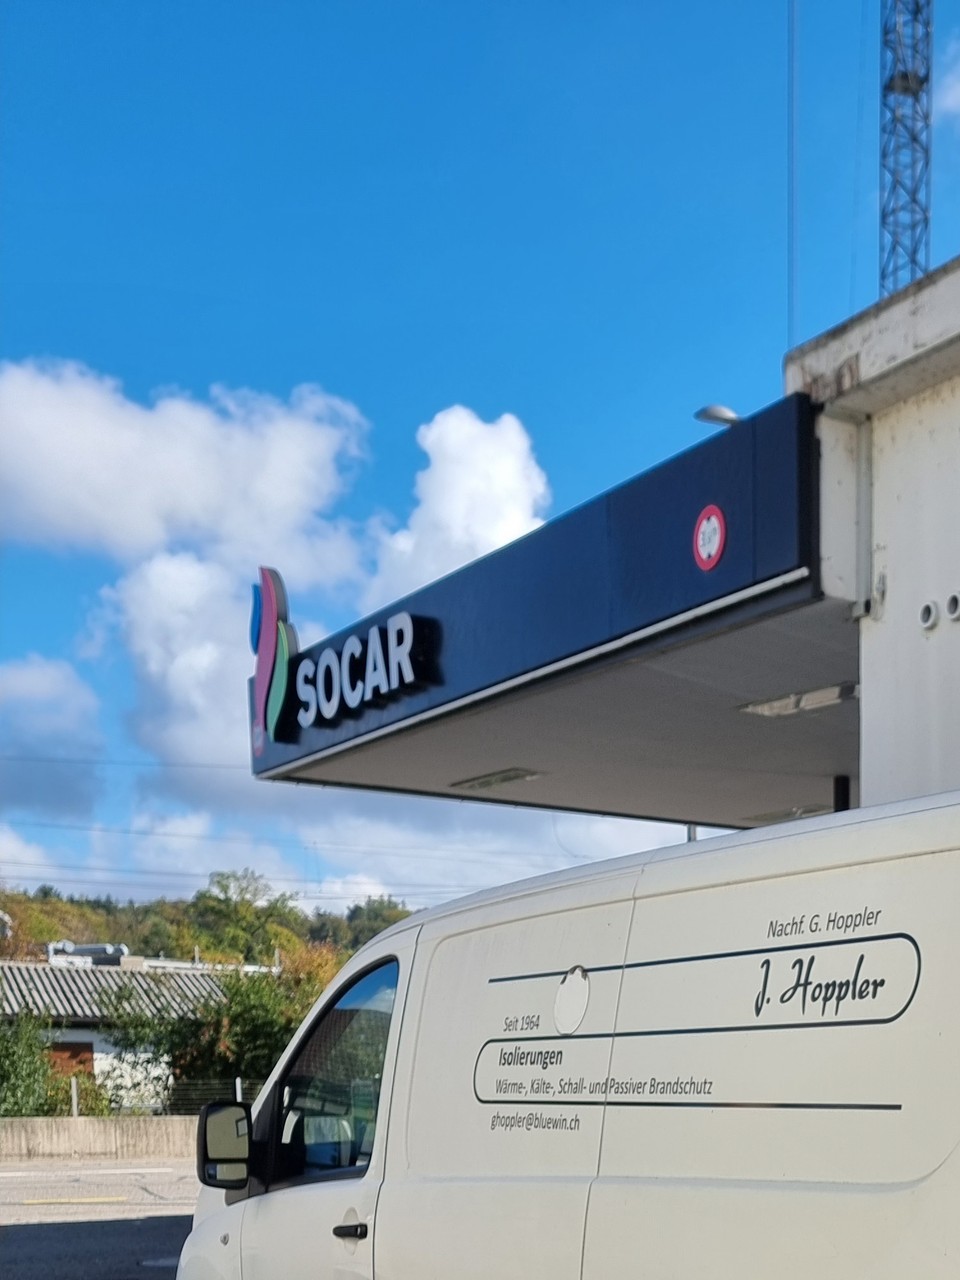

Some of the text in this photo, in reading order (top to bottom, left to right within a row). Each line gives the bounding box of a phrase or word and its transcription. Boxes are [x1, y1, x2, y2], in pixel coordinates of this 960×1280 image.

[296, 611, 415, 729] SOCAR
[767, 906, 882, 939] Nachf. G. Hoppler
[754, 953, 886, 1017] J. Hoppler
[503, 1015, 540, 1032] Seit 1964
[499, 1046, 563, 1070] Isolierungen
[557, 1077, 587, 1094] Schall-
[589, 1077, 608, 1094] und
[608, 1077, 647, 1095] Passiver
[649, 1076, 713, 1095] Brandschutz
[490, 1111, 581, 1131] ghoppler@bluewin.ch
